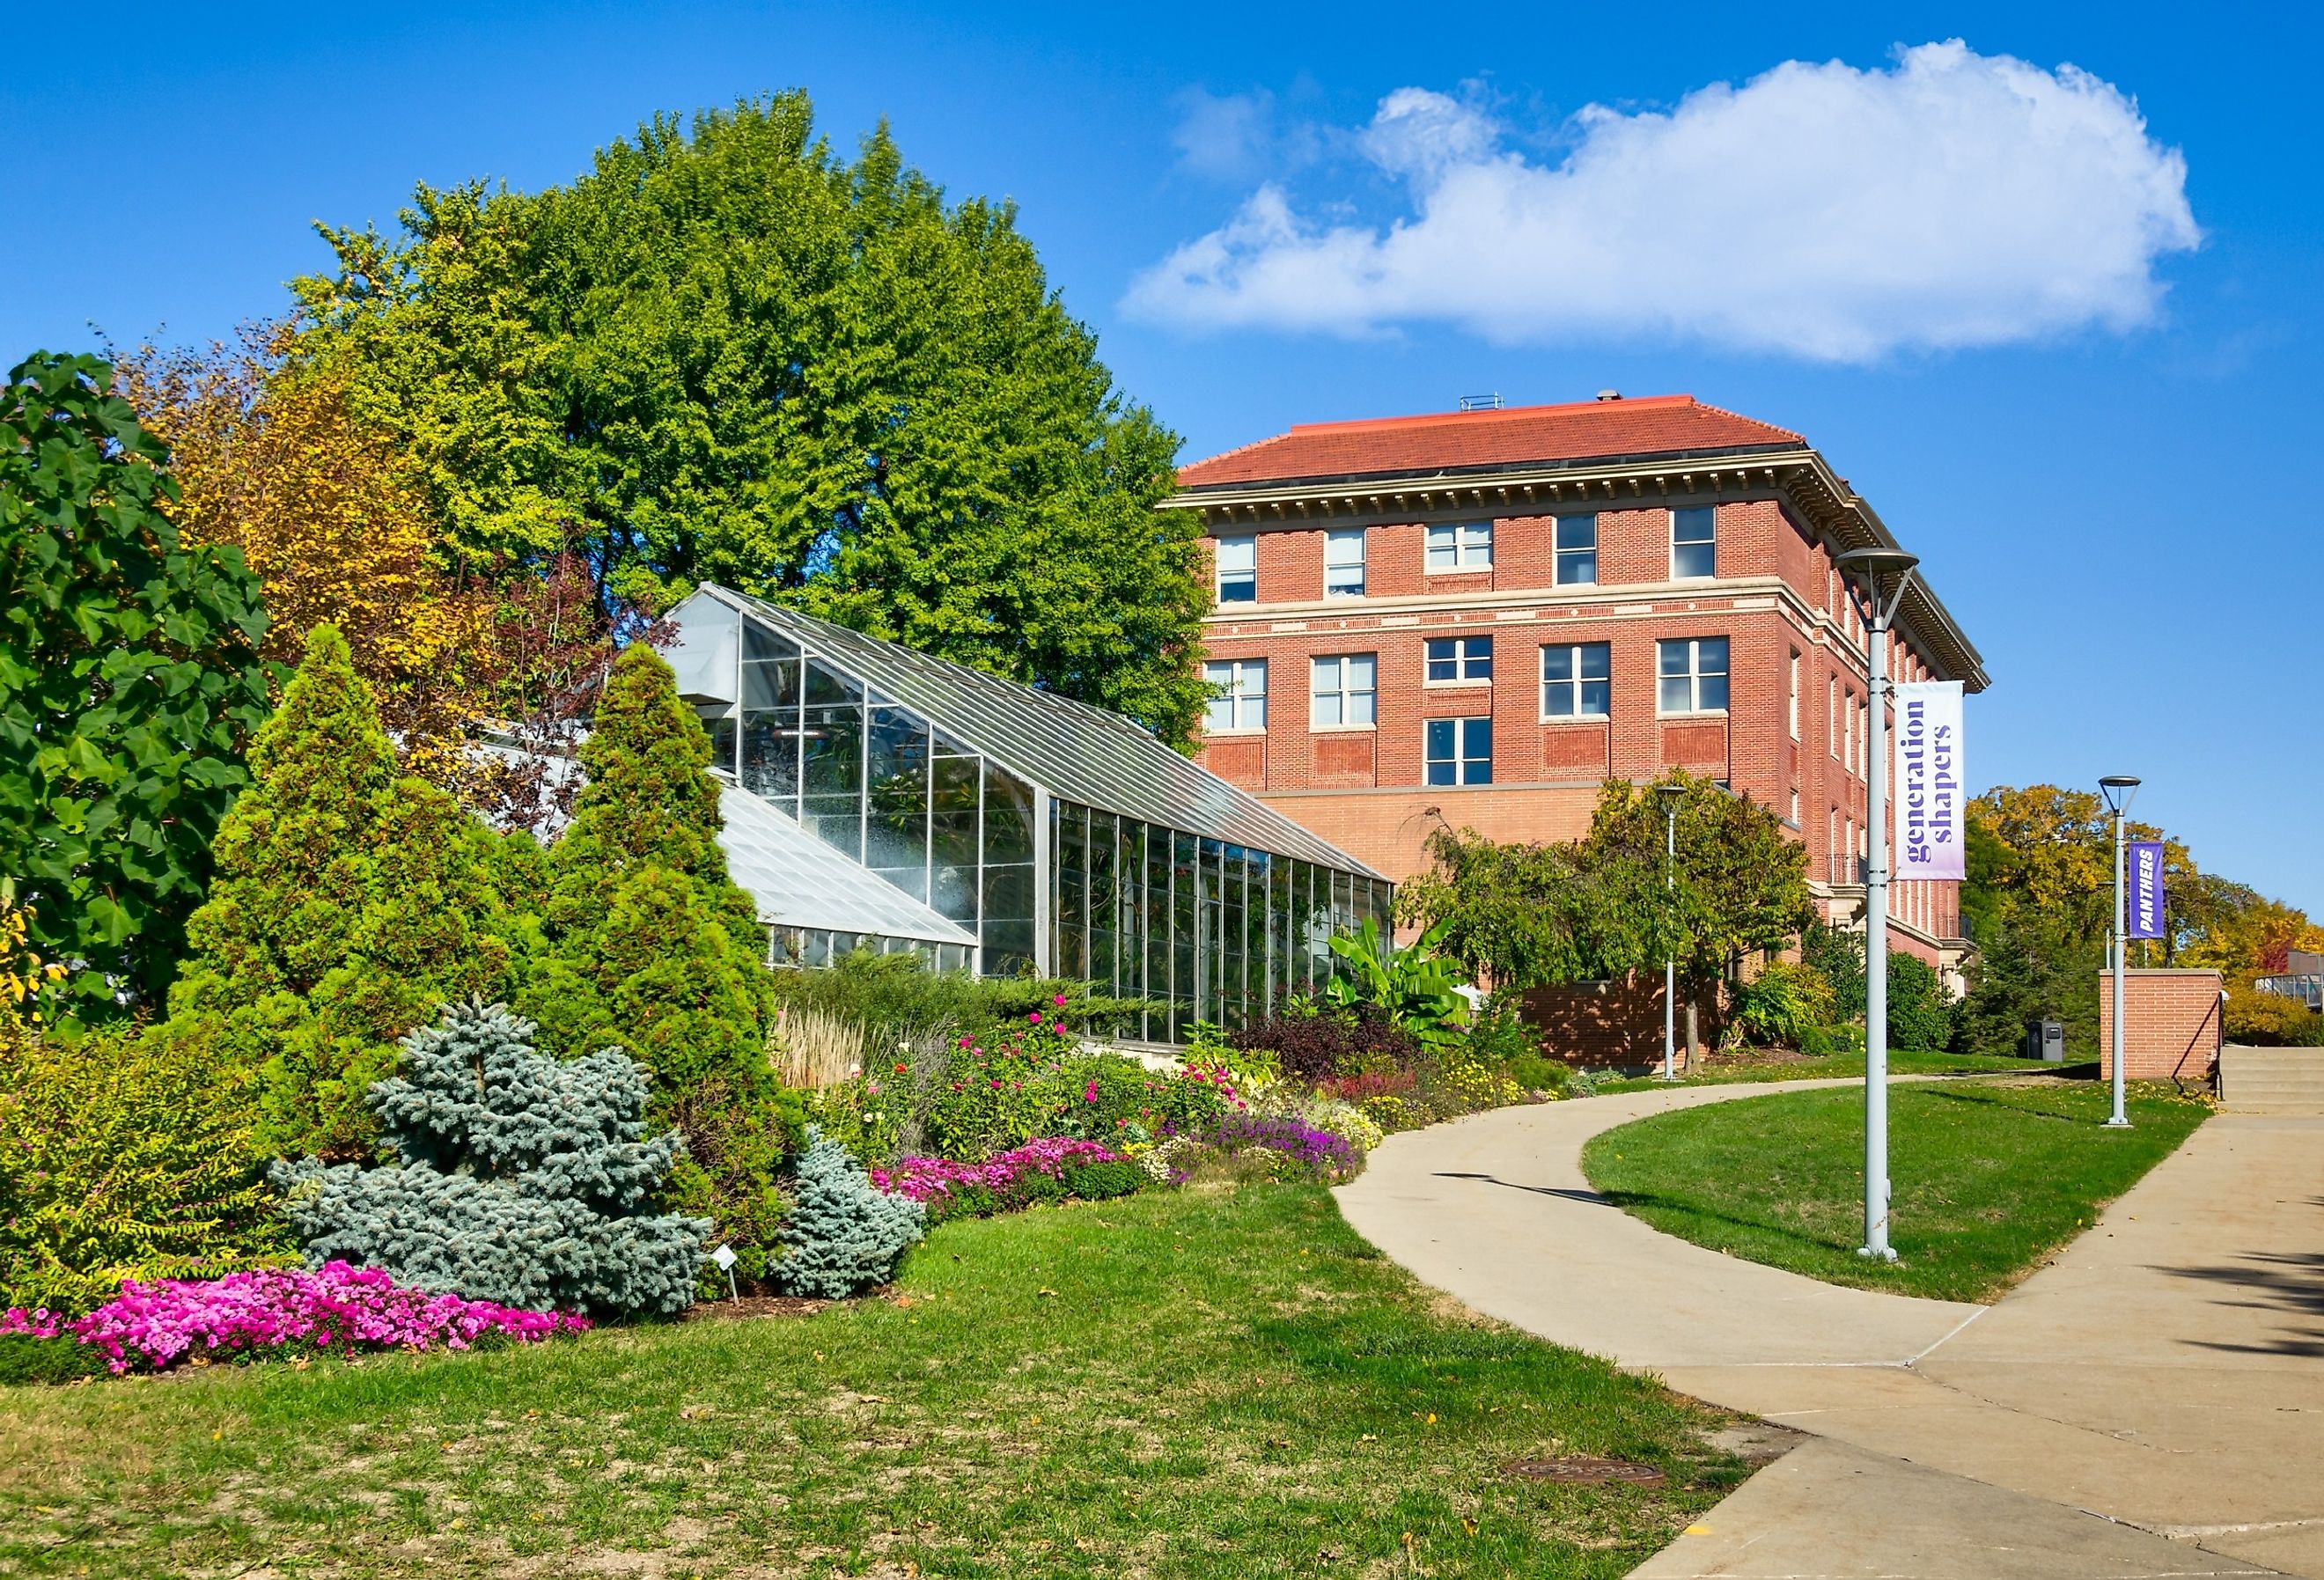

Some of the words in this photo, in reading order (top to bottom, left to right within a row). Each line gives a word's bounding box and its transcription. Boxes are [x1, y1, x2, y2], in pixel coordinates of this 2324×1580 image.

[1901, 700, 1931, 863] generation
[1929, 724, 1957, 843] shapers
[2139, 849, 2153, 933] PANTHERS
